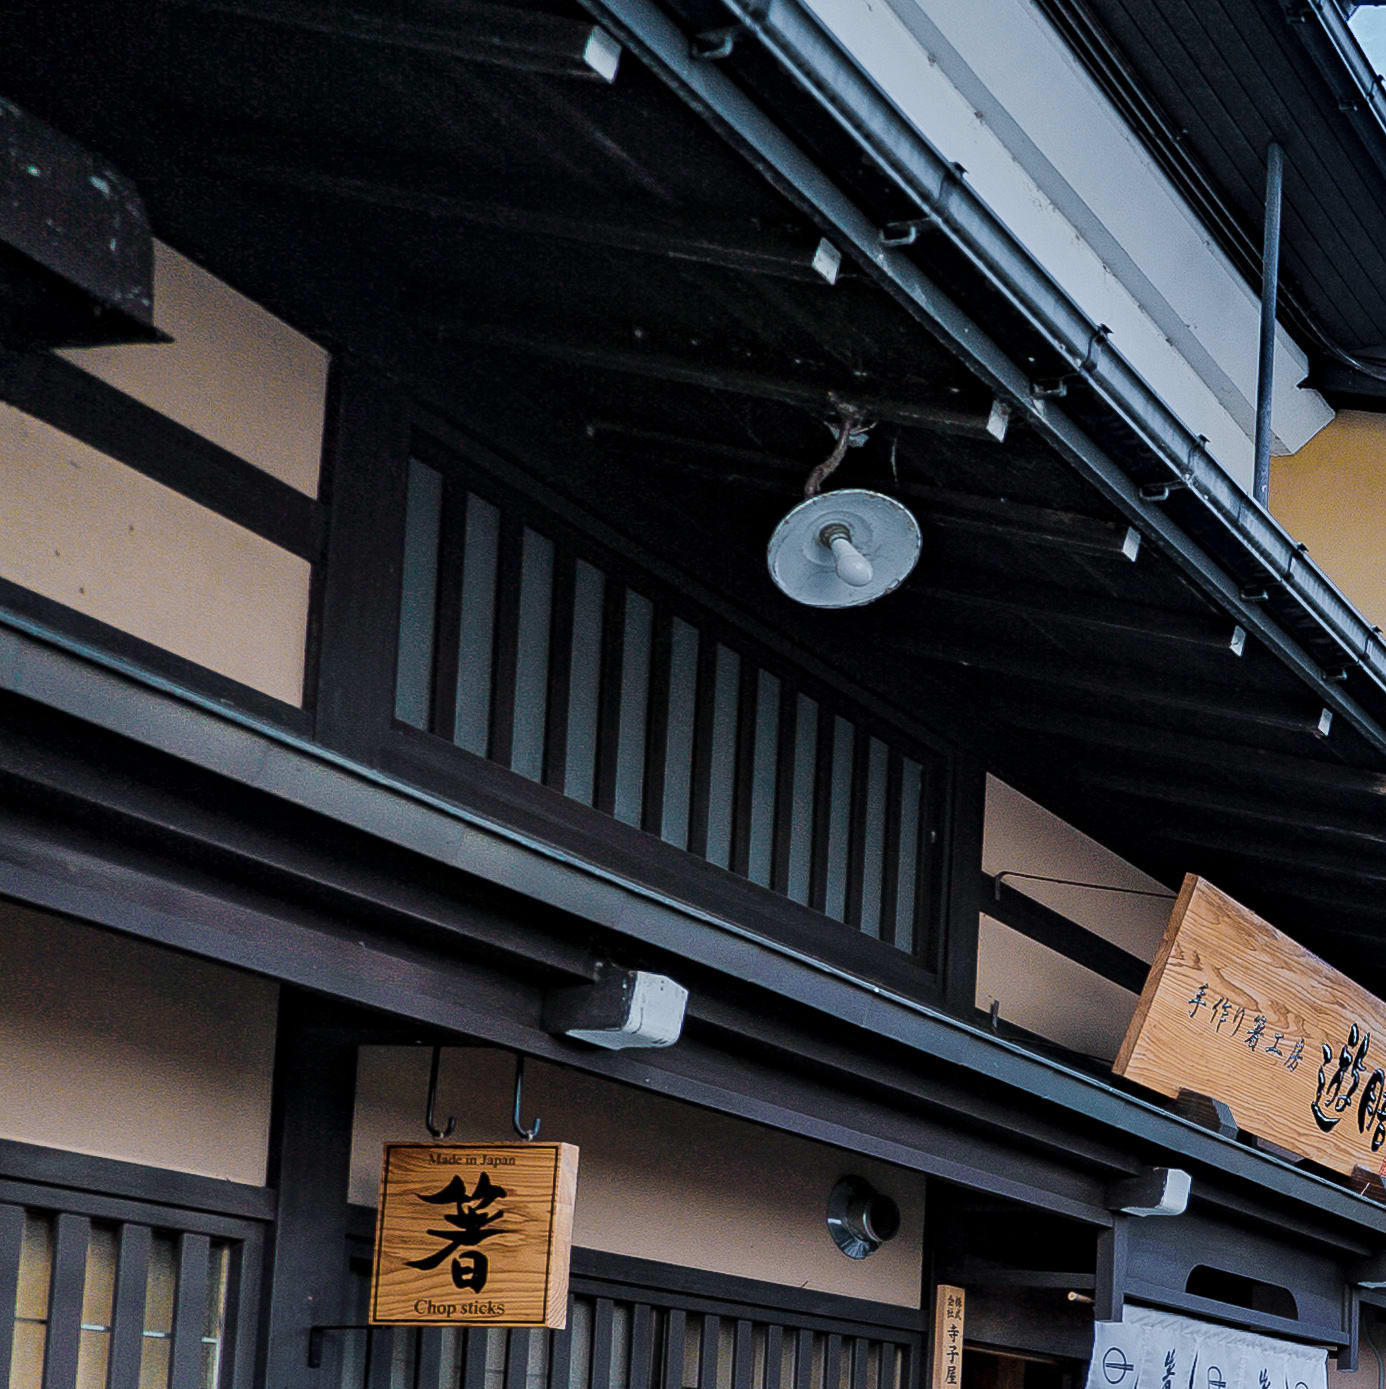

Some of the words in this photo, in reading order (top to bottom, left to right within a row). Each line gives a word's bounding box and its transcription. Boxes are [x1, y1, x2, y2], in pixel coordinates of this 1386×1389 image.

[1187, 984, 1306, 1073] 手作り箸工房
[429, 1153, 462, 1165] Made
[465, 1154, 477, 1165] in
[480, 1155, 516, 1168] Japan
[405, 1172, 521, 1294] 箸
[414, 1299, 457, 1317] Chop
[460, 1299, 505, 1315] sticks
[945, 1324, 959, 1385] 寺子屋
